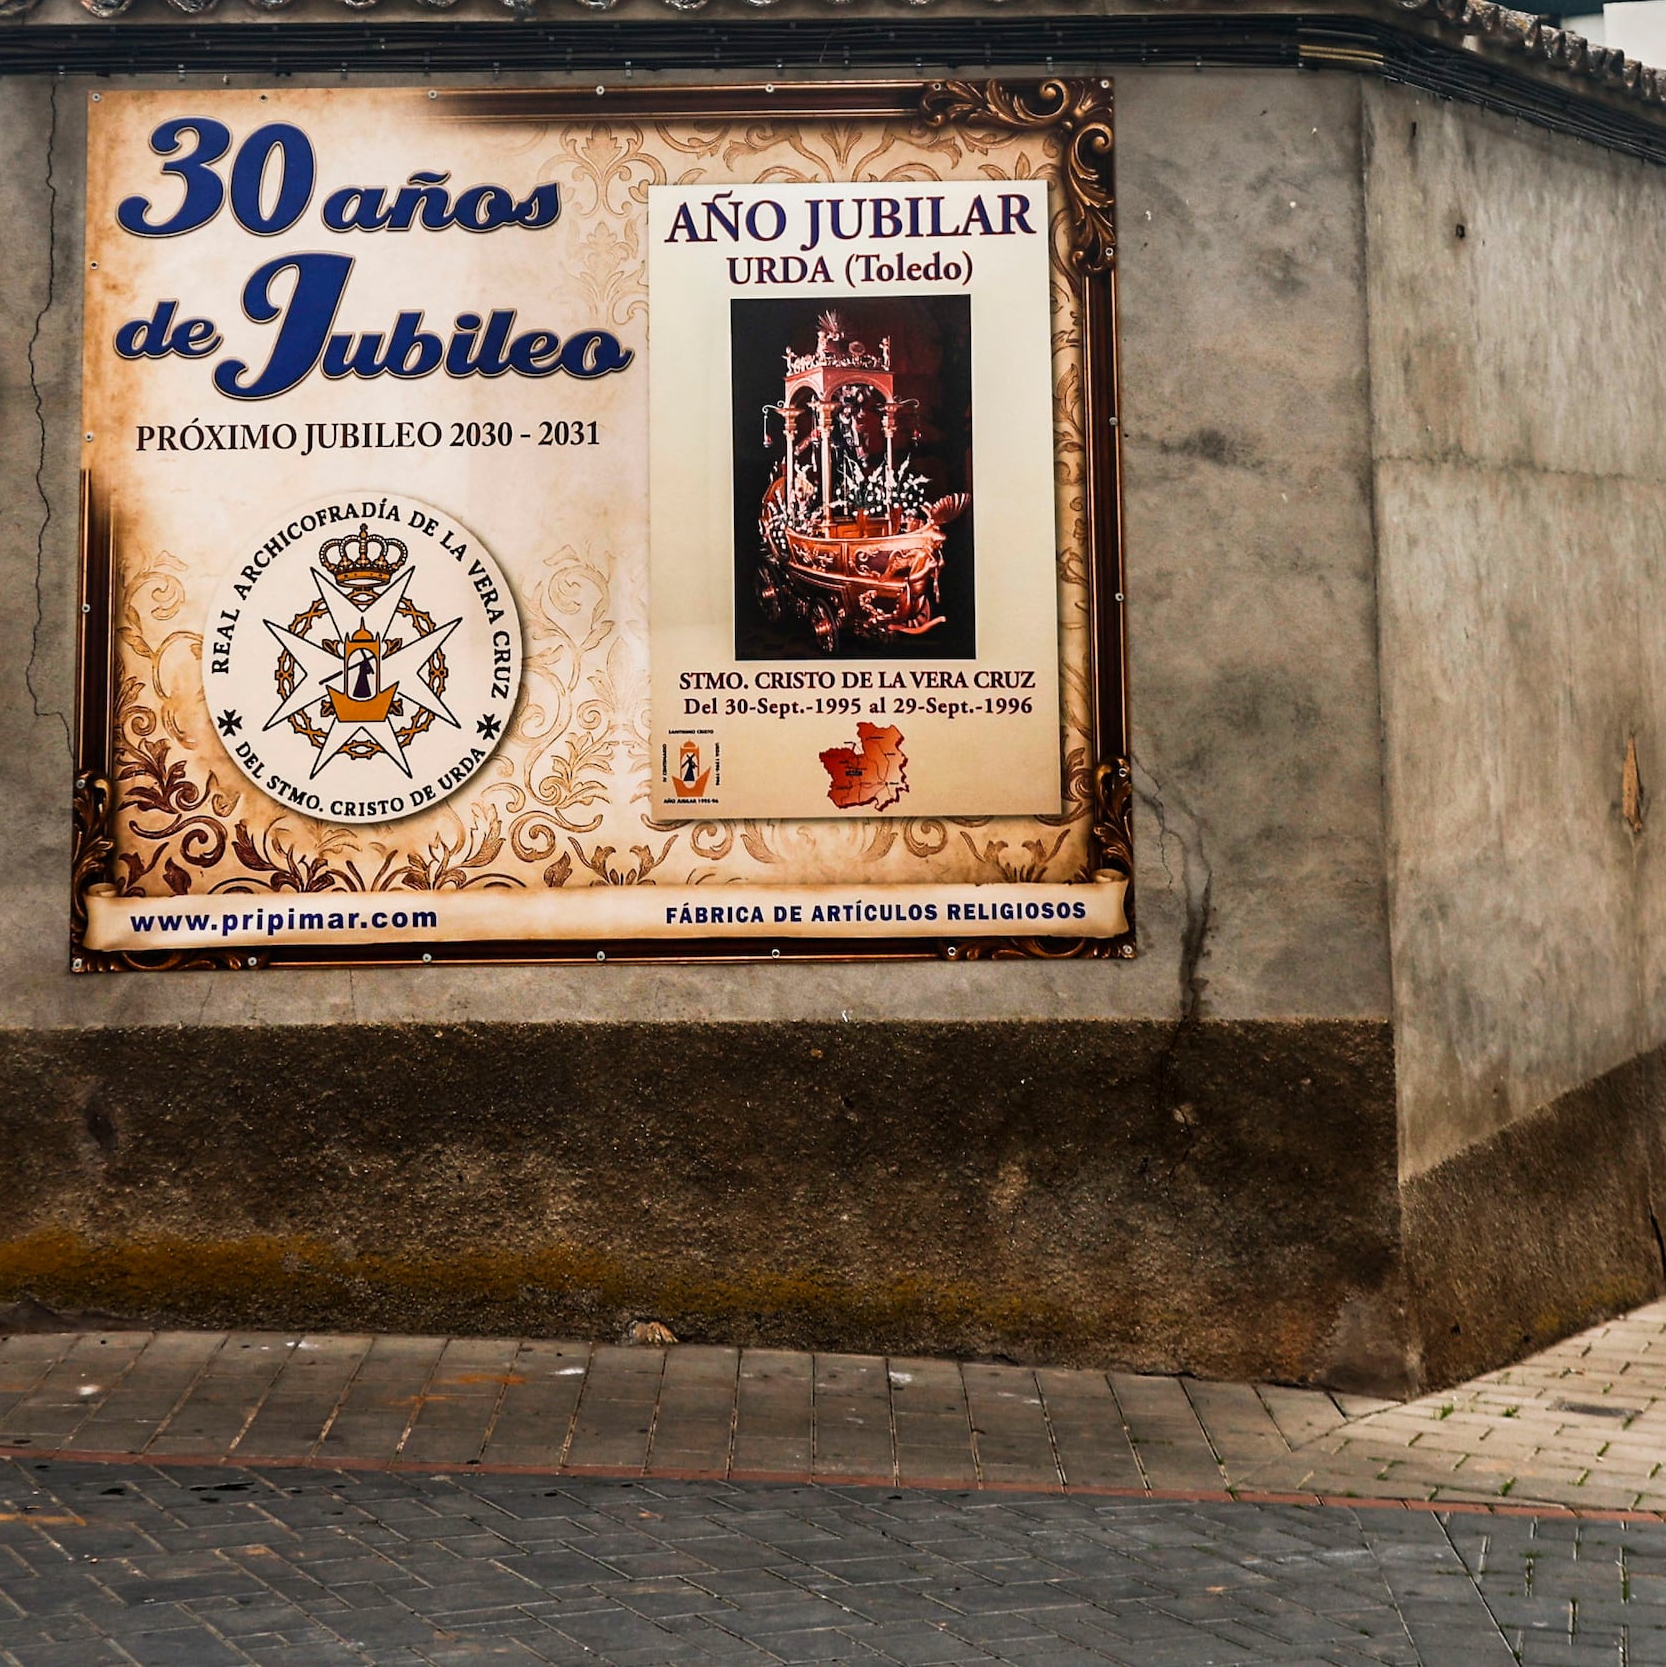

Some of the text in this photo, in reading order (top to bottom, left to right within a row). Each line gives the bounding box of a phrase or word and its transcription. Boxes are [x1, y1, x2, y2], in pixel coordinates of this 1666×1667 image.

[116, 116, 562, 237] 30 años
[664, 190, 1037, 252] AÑO JUBILAR
[726, 250, 974, 288] URDA (Toledo)
[113, 249, 636, 402] de Jubileo
[135, 417, 298, 452] PRÓXIMO
[300, 420, 443, 456] JUBILEO
[448, 420, 513, 448] 2030
[536, 420, 601, 447] 2031
[211, 498, 511, 700] REAL ARCHICOFRADÍA DE LA VERA CRUZ
[679, 670, 1036, 690] STMO. CRISTO DE LA VERA CRUZ
[683, 695, 1033, 720] Del 30-Sept.-1995 al 29-Sept.-1996
[234, 741, 486, 818] DEL STMO. CRISTO DE URDA
[130, 907, 438, 936] www.pripimar.com
[665, 899, 1087, 924] FÁBRICA DE ARTÍCULOS RELIGIOSOS
